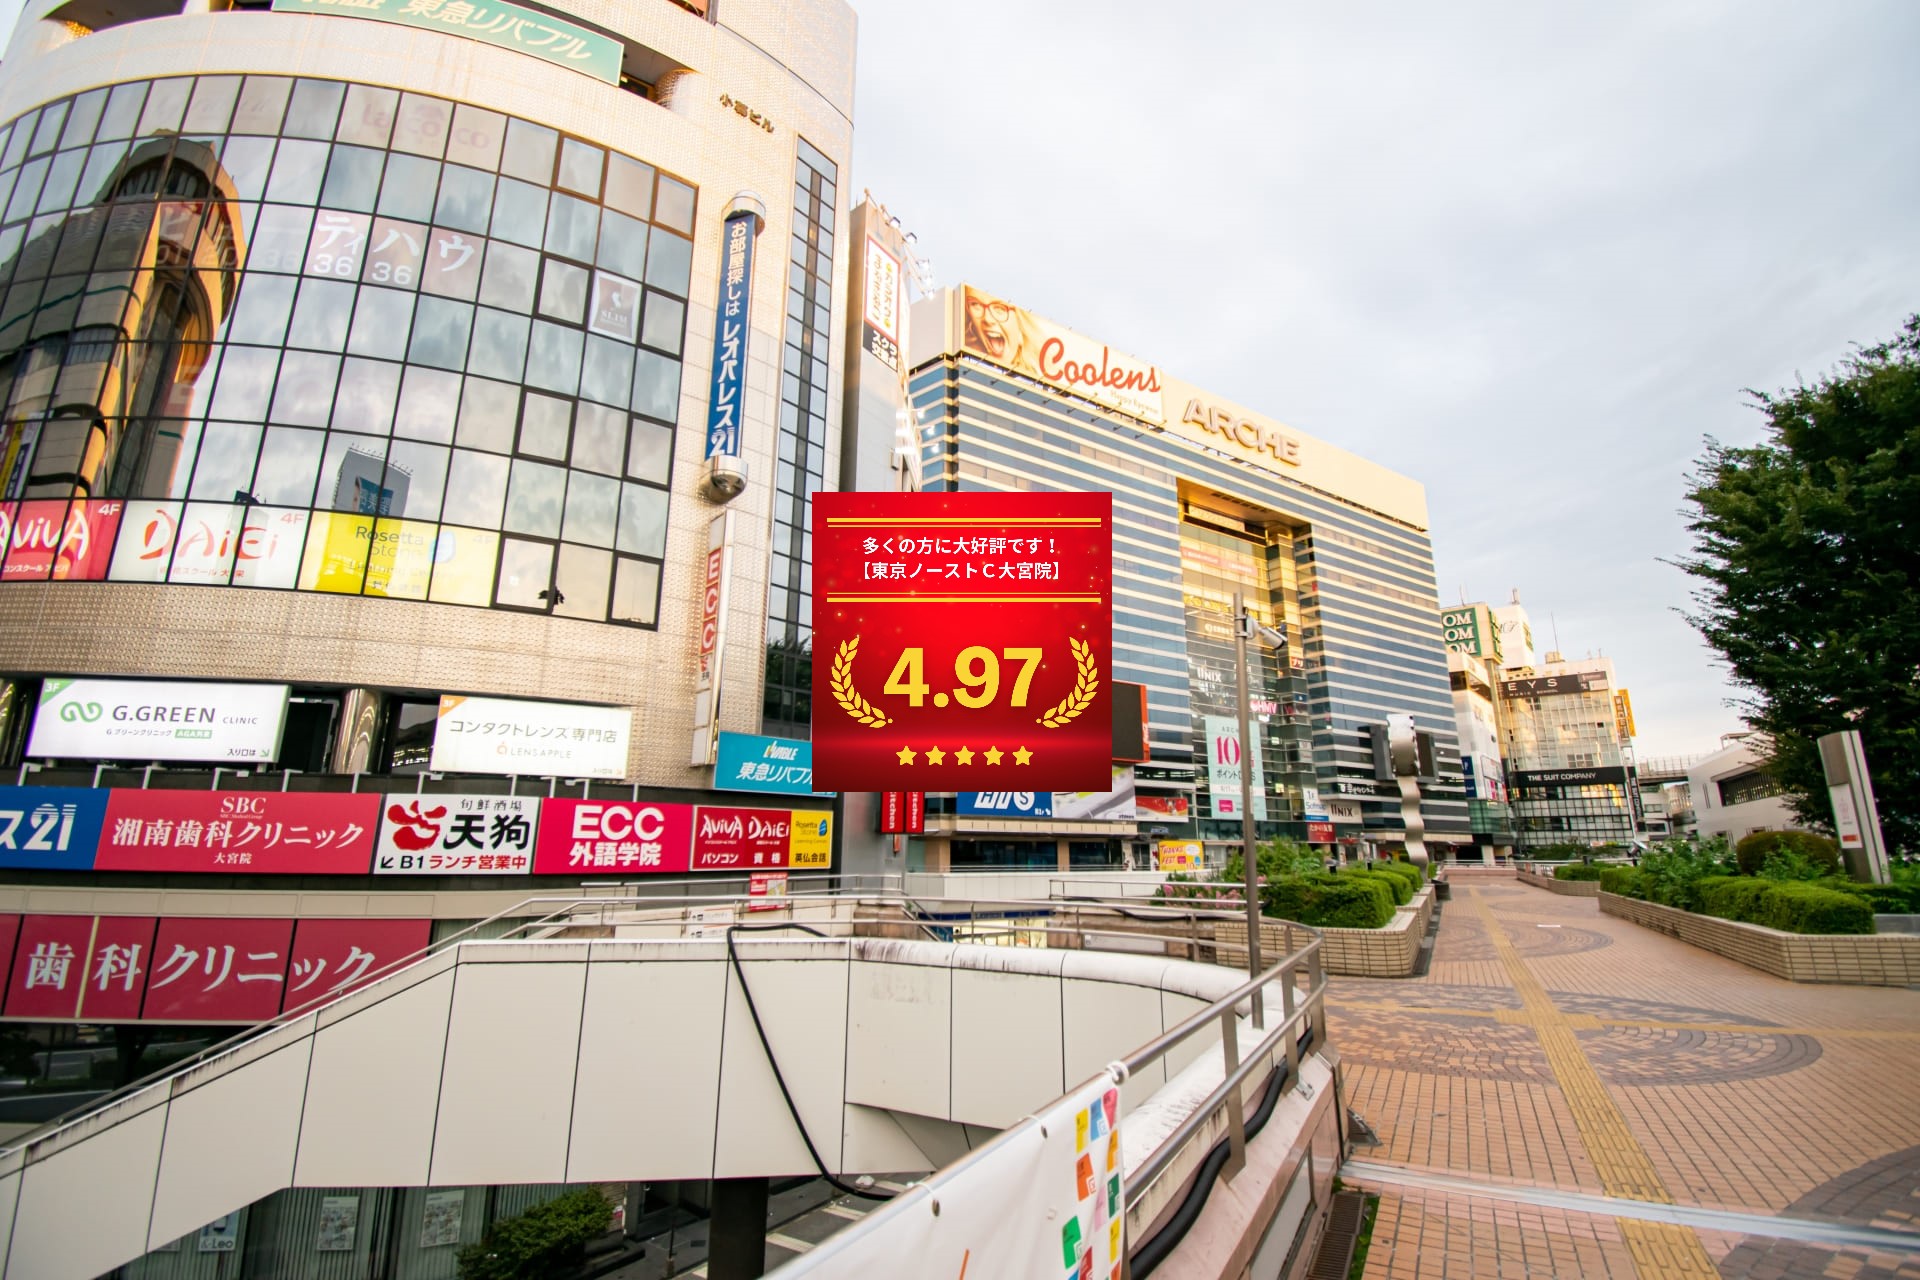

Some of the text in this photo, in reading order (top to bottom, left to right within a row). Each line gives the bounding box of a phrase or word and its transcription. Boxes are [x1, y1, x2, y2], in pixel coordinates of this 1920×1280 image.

[406, 0, 592, 60] 東急リバブル
[313, 253, 354, 276] 36
[371, 261, 412, 285] 36
[725, 221, 748, 316] お部屋探しは
[1039, 337, 1161, 393] Coolens
[709, 318, 742, 457] レオパレス21
[1182, 399, 1301, 467] ARCHE
[98, 503, 121, 516] 4F
[280, 512, 306, 525] 4F
[1442, 611, 1473, 627] OM
[1444, 626, 1475, 642] OM
[45, 682, 60, 693] 3F
[112, 705, 259, 725] G.GREEN CLINIC
[220, 796, 267, 815] SBC
[111, 818, 365, 849] 湘南歯科クリニック
[442, 813, 531, 850] 天狗
[571, 804, 666, 841] ECC
[213, 851, 253, 865] 大宮院
[400, 855, 528, 870] B1 ランチ営業中
[568, 841, 662, 867] 外語学院
[701, 852, 739, 865] パソコン
[25, 942, 376, 993] 歯科クリニック
